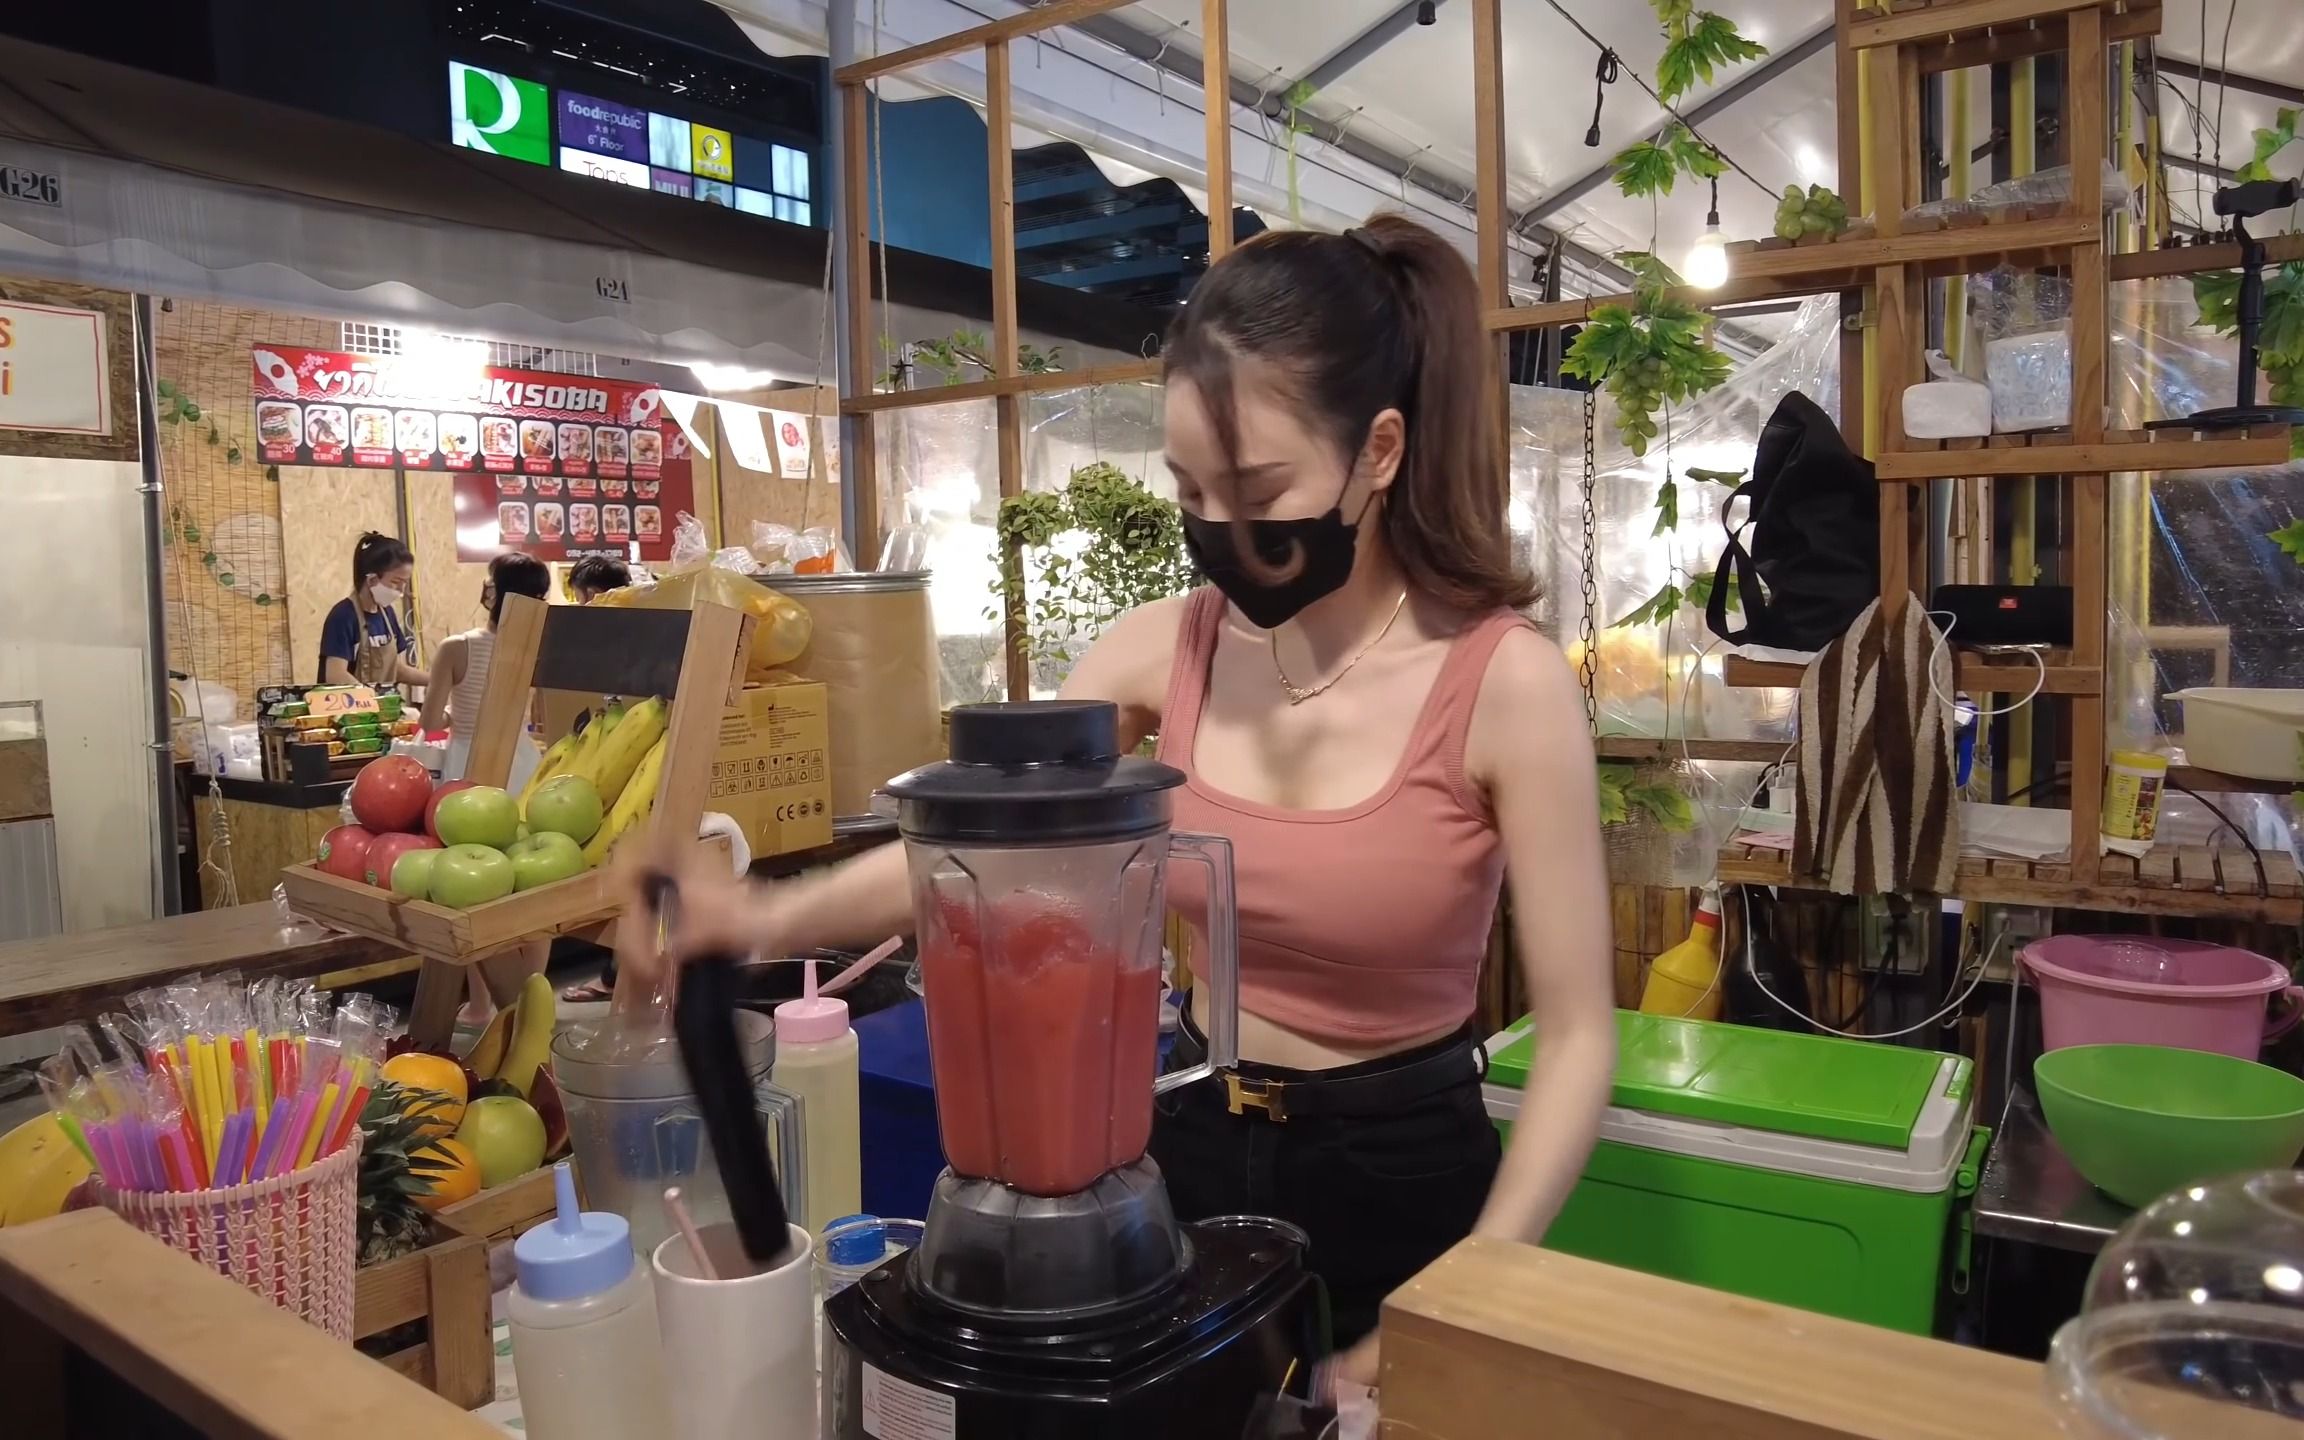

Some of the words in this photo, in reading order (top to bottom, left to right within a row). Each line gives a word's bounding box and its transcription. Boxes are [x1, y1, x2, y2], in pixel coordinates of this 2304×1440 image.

[567, 100, 642, 130] foodrepublic
[0, 167, 59, 203] G26
[324, 692, 356, 712] 20
